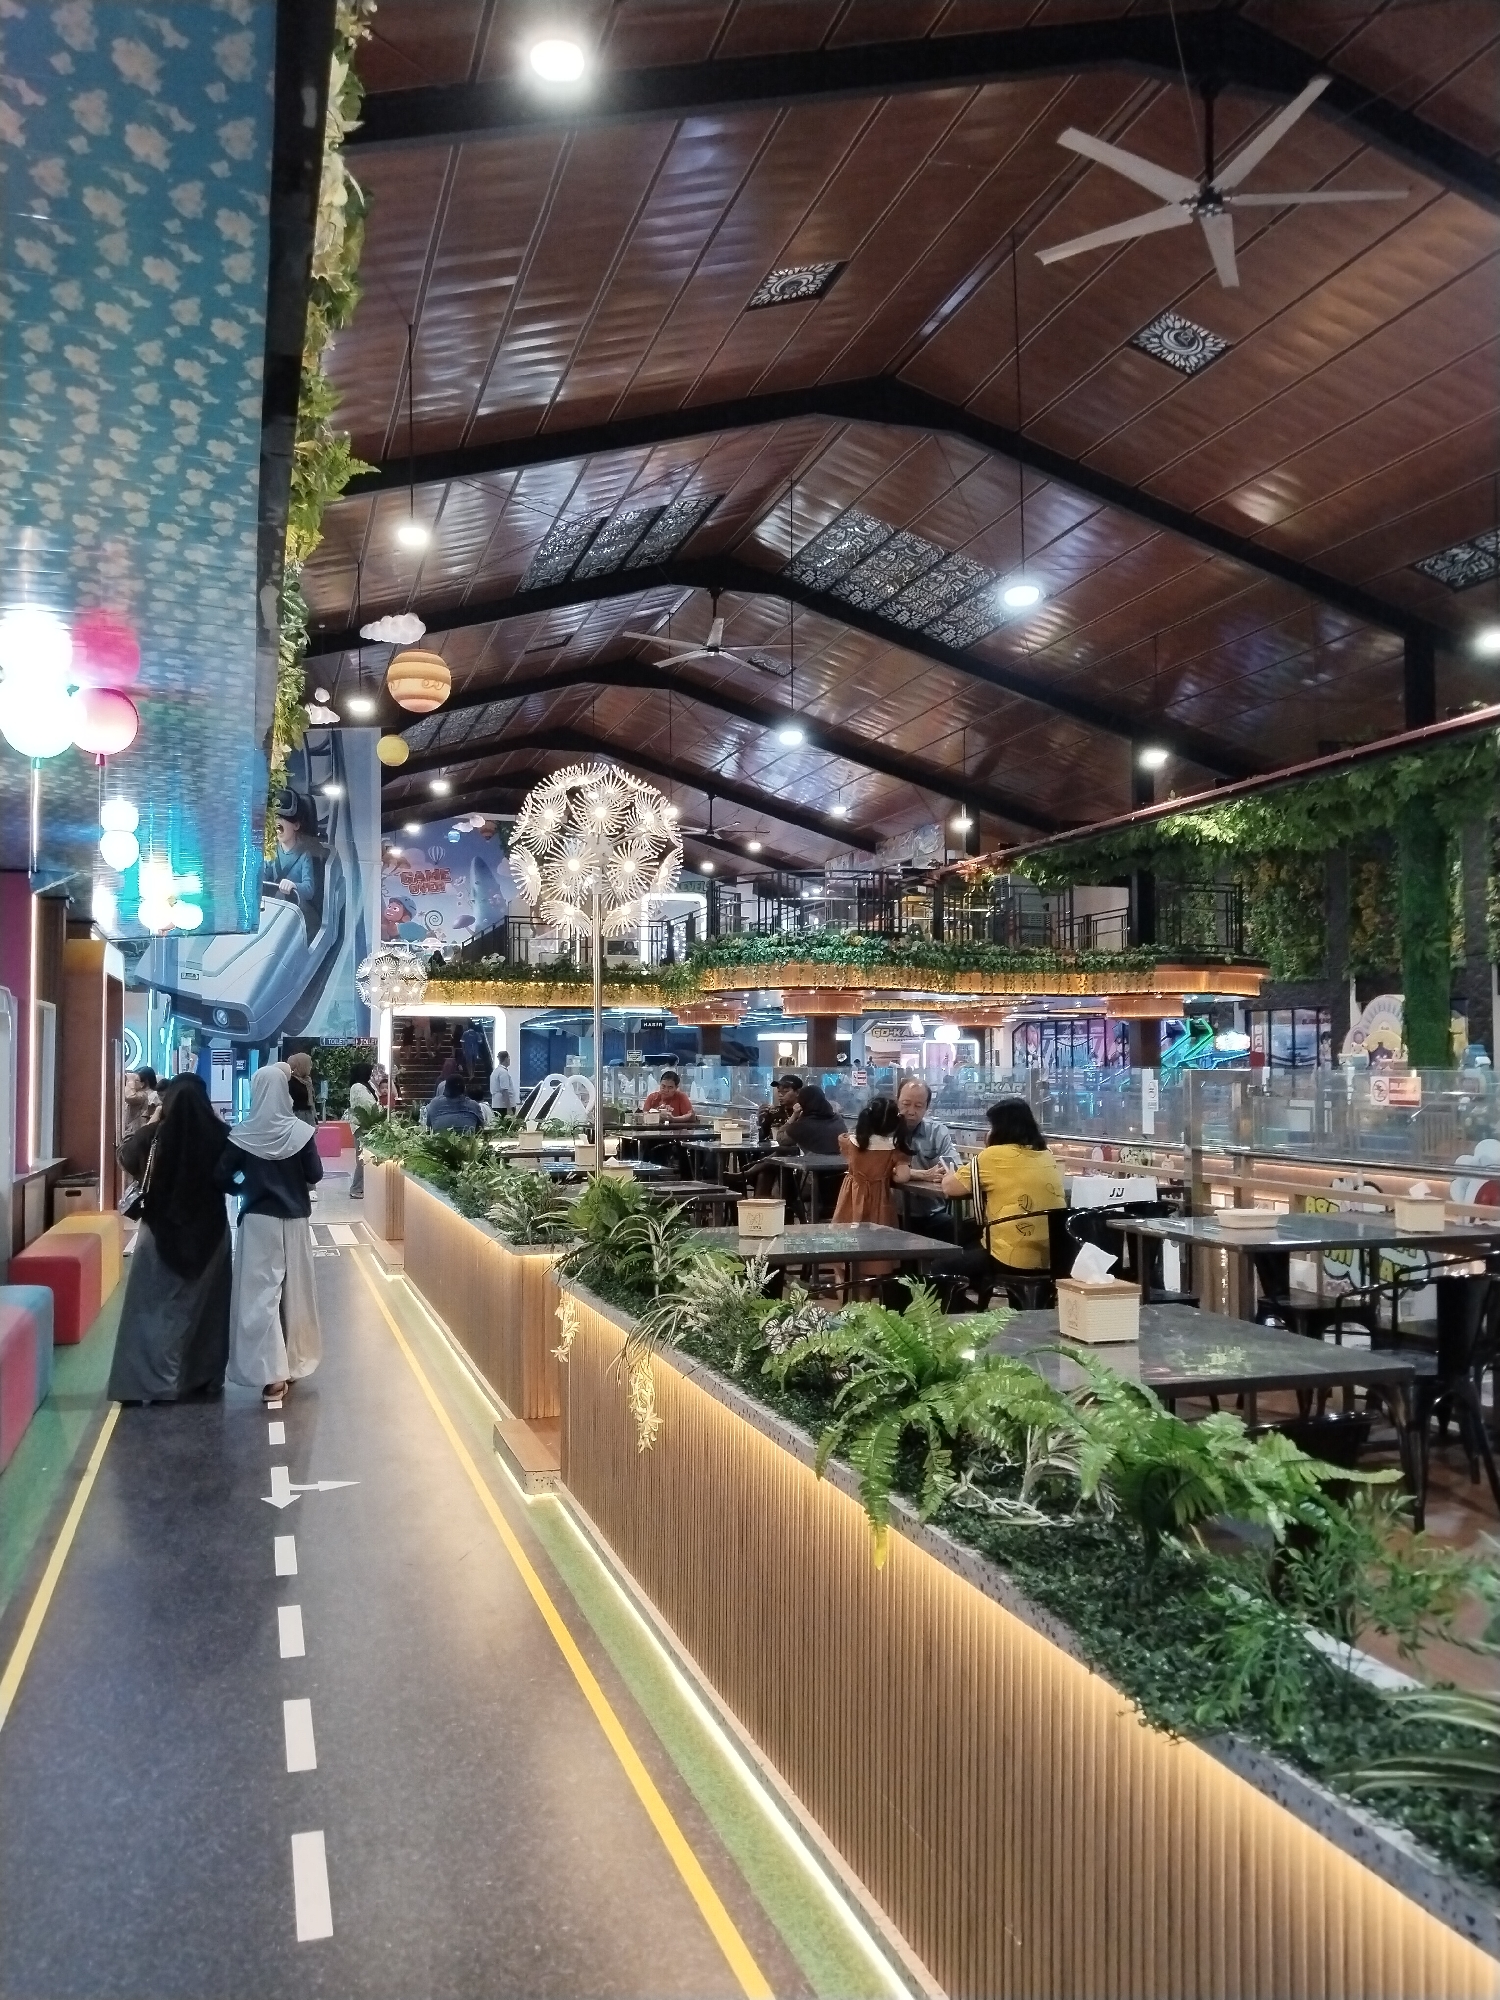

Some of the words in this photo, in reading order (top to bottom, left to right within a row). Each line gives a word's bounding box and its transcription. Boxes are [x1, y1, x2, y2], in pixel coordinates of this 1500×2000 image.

[400, 868, 452, 886] GAME
[409, 882, 446, 896] OVER
[872, 1028, 925, 1038] GO-KA
